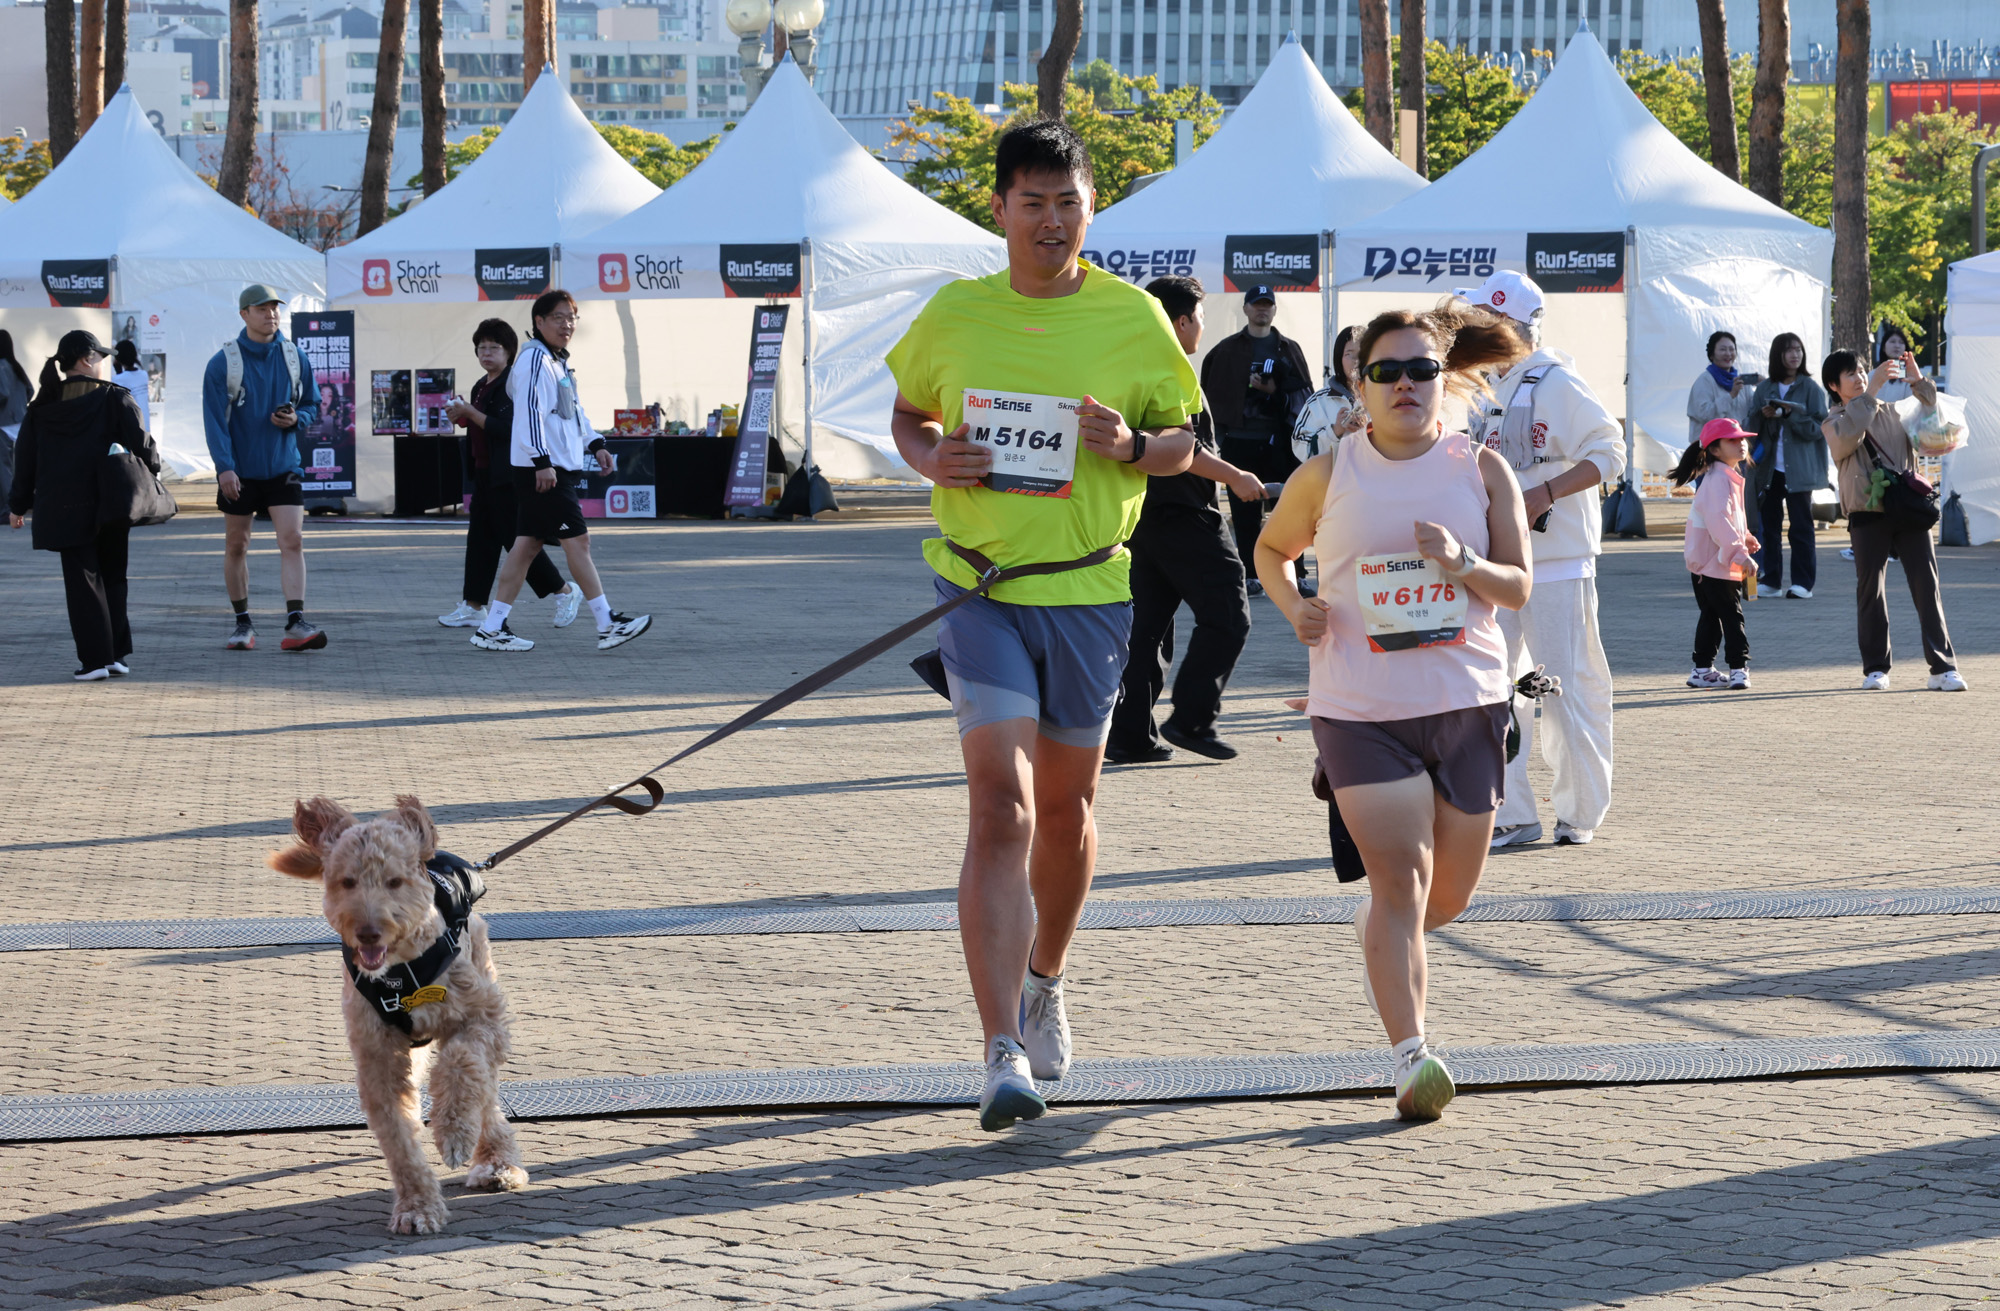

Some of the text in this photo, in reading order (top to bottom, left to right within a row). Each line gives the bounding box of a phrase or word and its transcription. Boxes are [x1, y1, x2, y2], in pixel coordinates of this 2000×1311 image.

[635, 254, 683, 275] Short
[727, 260, 753, 277] Run
[1106, 249, 1197, 284] 오늘덤핑
[1232, 251, 1263, 269] Run
[1397, 247, 1497, 285] 오늘덤핑
[1535, 250, 1567, 269] Run
[396, 259, 442, 279] Short
[481, 264, 506, 280] Run
[47, 274, 71, 290] Run
[968, 395, 992, 409] Run
[1057, 402, 1076, 411] 5km
[975, 426, 1063, 452] M 5164
[1004, 453, 1026, 463] 임준모
[1361, 563, 1386, 576] Run
[1372, 583, 1456, 606] W 6176
